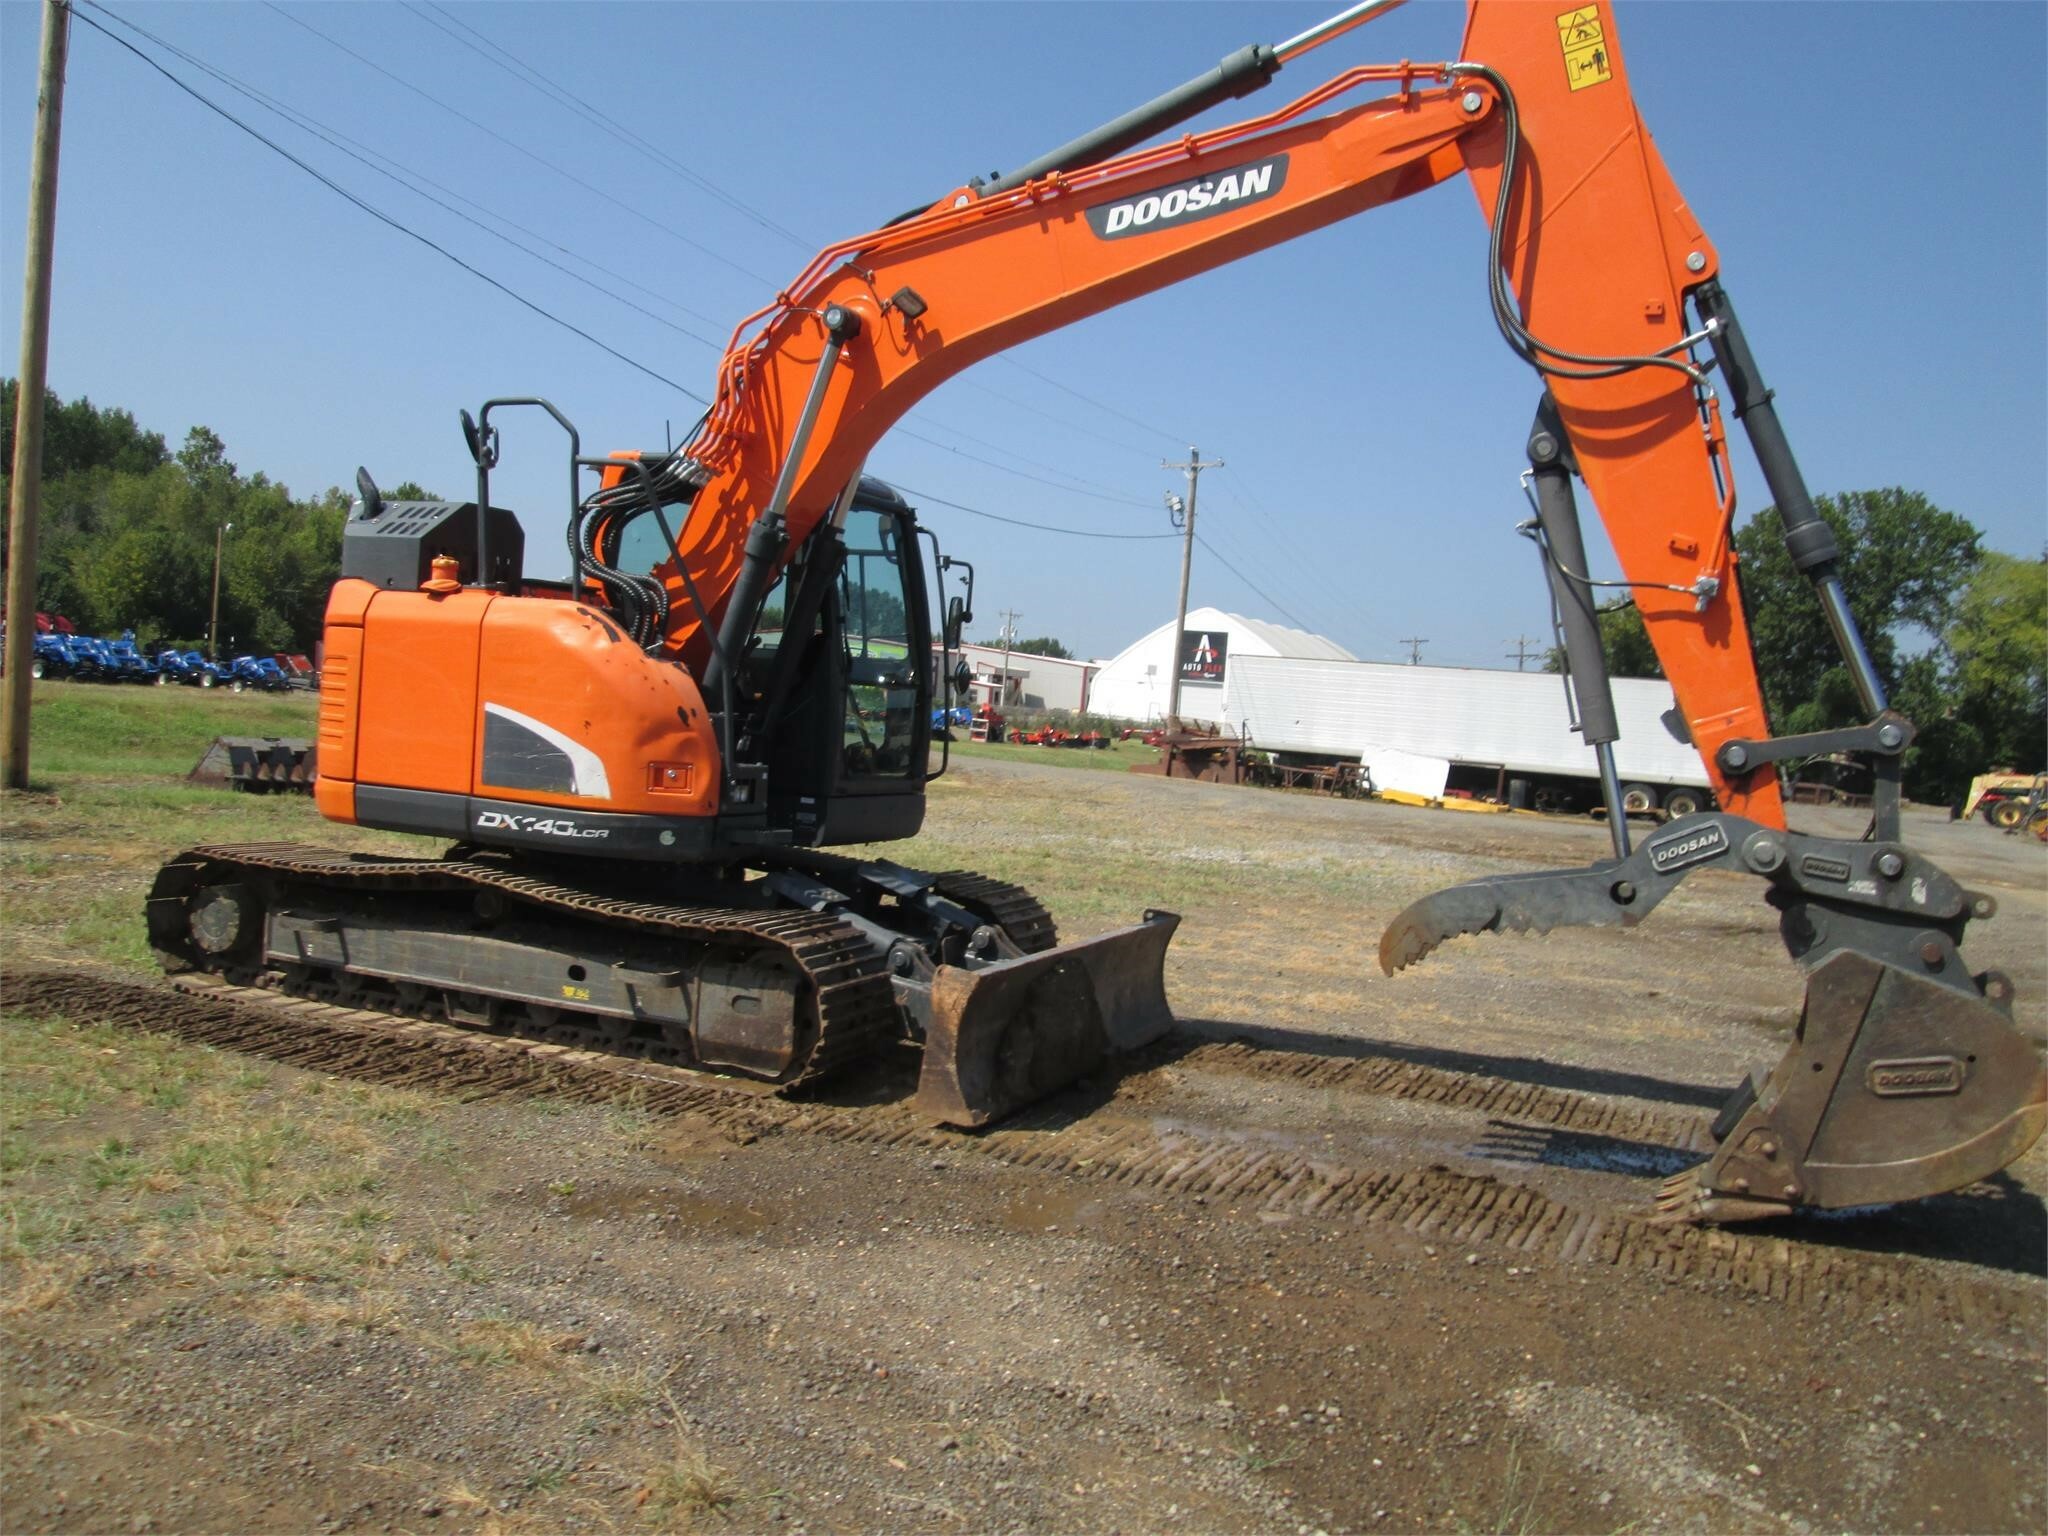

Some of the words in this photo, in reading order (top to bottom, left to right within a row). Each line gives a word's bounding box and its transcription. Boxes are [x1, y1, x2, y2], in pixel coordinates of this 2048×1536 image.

[1105, 164, 1273, 234] DOOSAN
[1183, 663, 1202, 672] AUTO
[1657, 831, 1720, 862] DOOSAN
